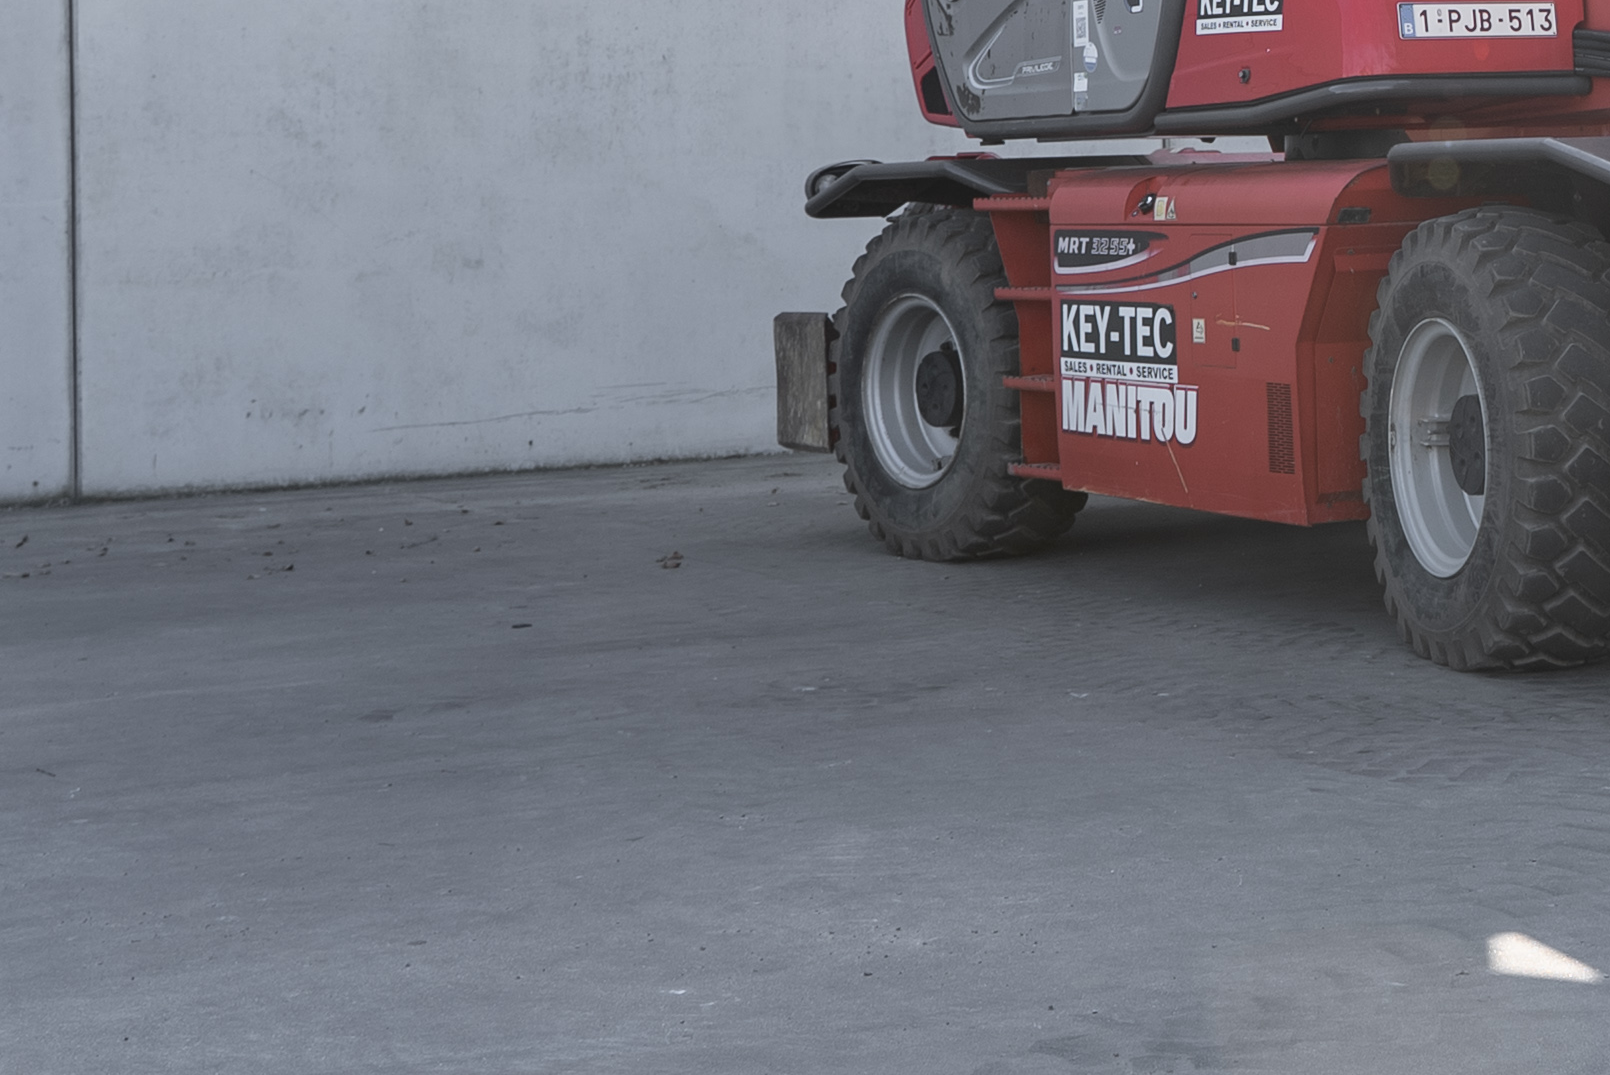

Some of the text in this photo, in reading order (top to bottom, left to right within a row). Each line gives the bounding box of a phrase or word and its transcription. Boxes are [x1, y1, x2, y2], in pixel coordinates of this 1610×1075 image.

[1201, 18, 1278, 31] SALES RENTAL SERVICE
[1404, 7, 1553, 35] B 1-PJB-513
[1057, 236, 1090, 254] MRT
[1062, 303, 1174, 358] KEY-TEC
[1064, 360, 1174, 380] SALES RENTAL SERVICE
[1061, 377, 1199, 445] MANITOU
